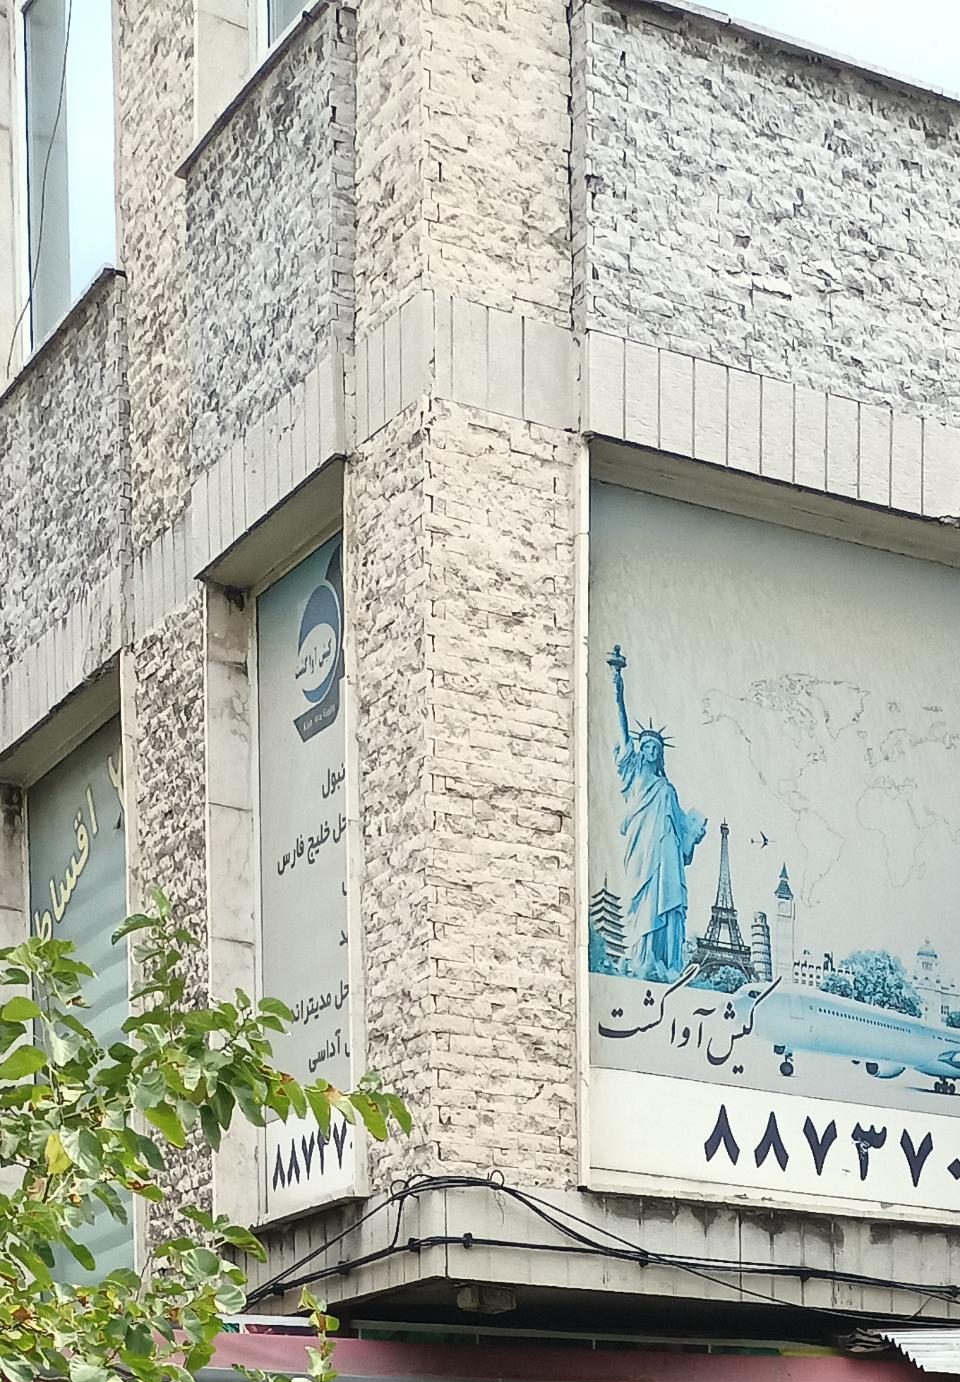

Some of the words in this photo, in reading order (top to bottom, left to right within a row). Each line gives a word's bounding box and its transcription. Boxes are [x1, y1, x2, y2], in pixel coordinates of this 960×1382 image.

[277, 833, 305, 876] فارس
[308, 820, 331, 865] خلیج
[598, 963, 700, 1039] گشت
[670, 1007, 716, 1049] آوا
[706, 975, 782, 1075] کیش
